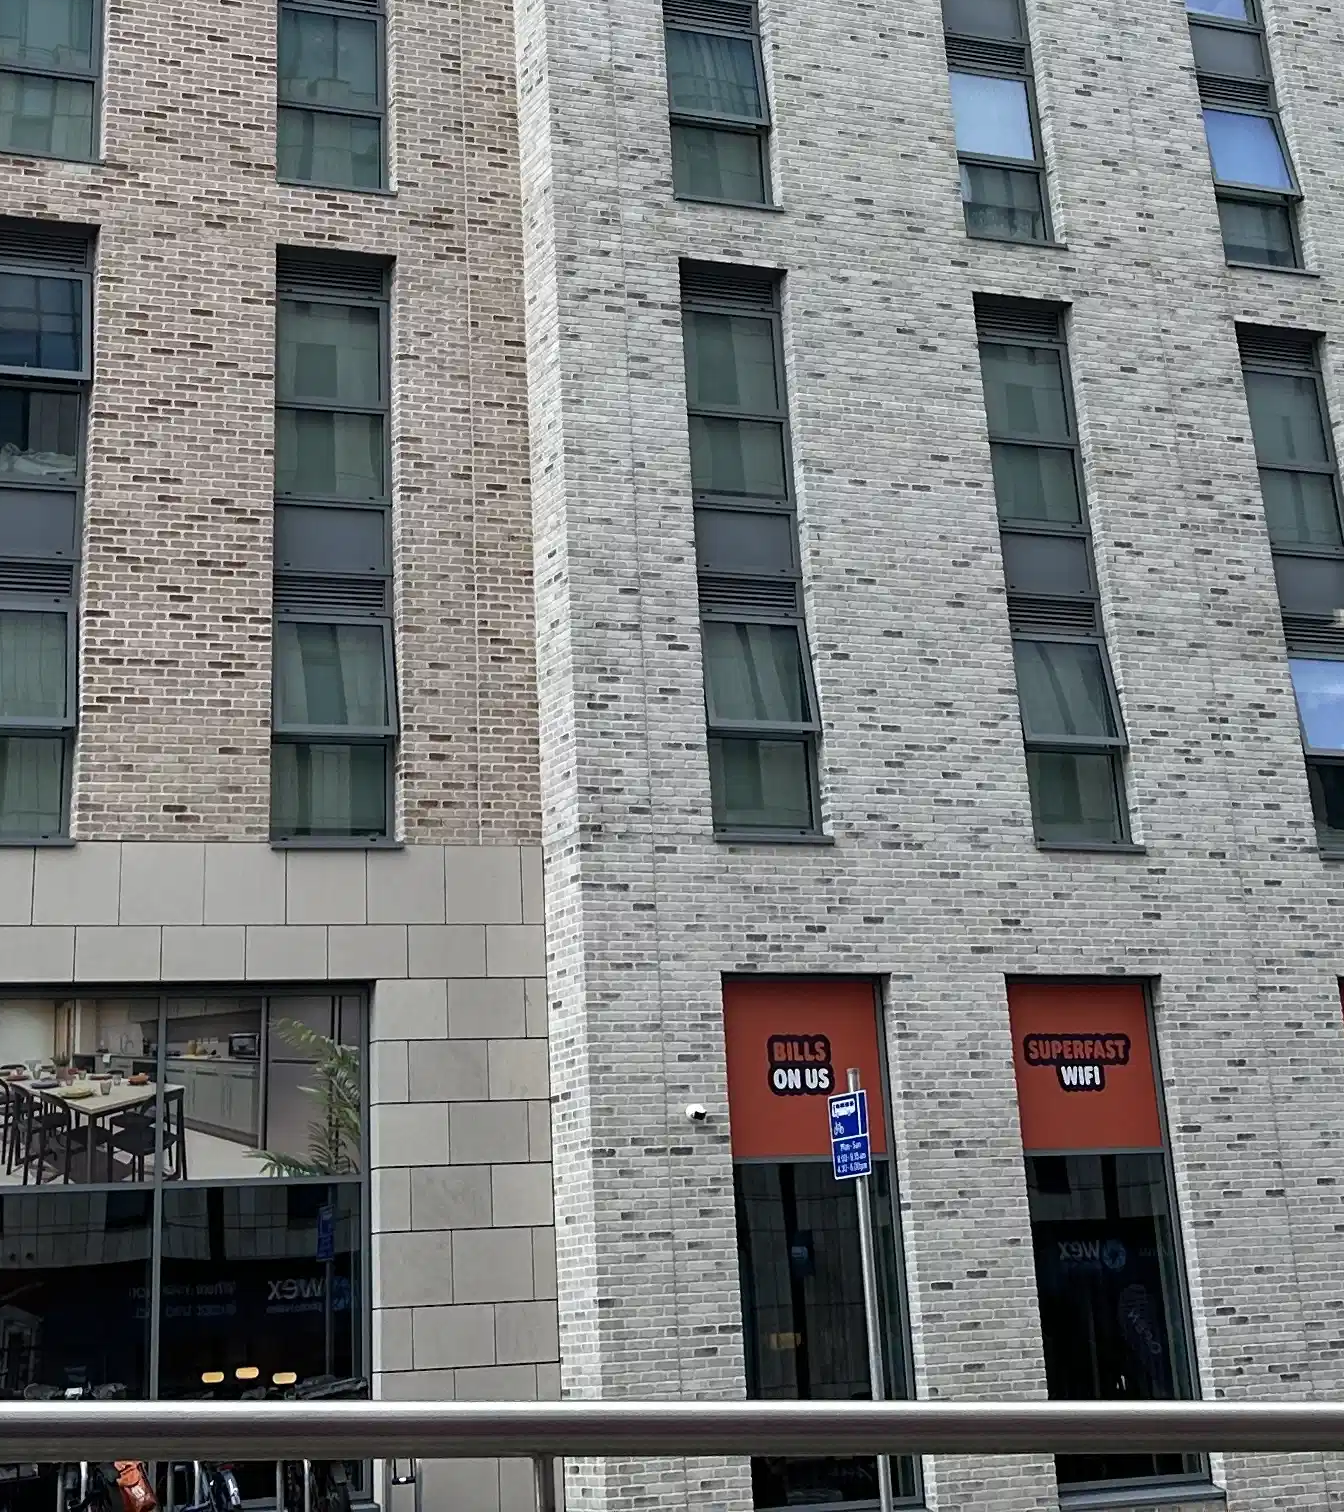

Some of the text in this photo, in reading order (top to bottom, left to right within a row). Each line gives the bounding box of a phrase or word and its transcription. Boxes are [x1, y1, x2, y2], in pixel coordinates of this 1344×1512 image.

[773, 1041, 826, 1061] BILLS
[1028, 1039, 1126, 1059] SUPERFAST
[773, 1067, 830, 1089] ON US
[1061, 1065, 1101, 1085] WIFI
